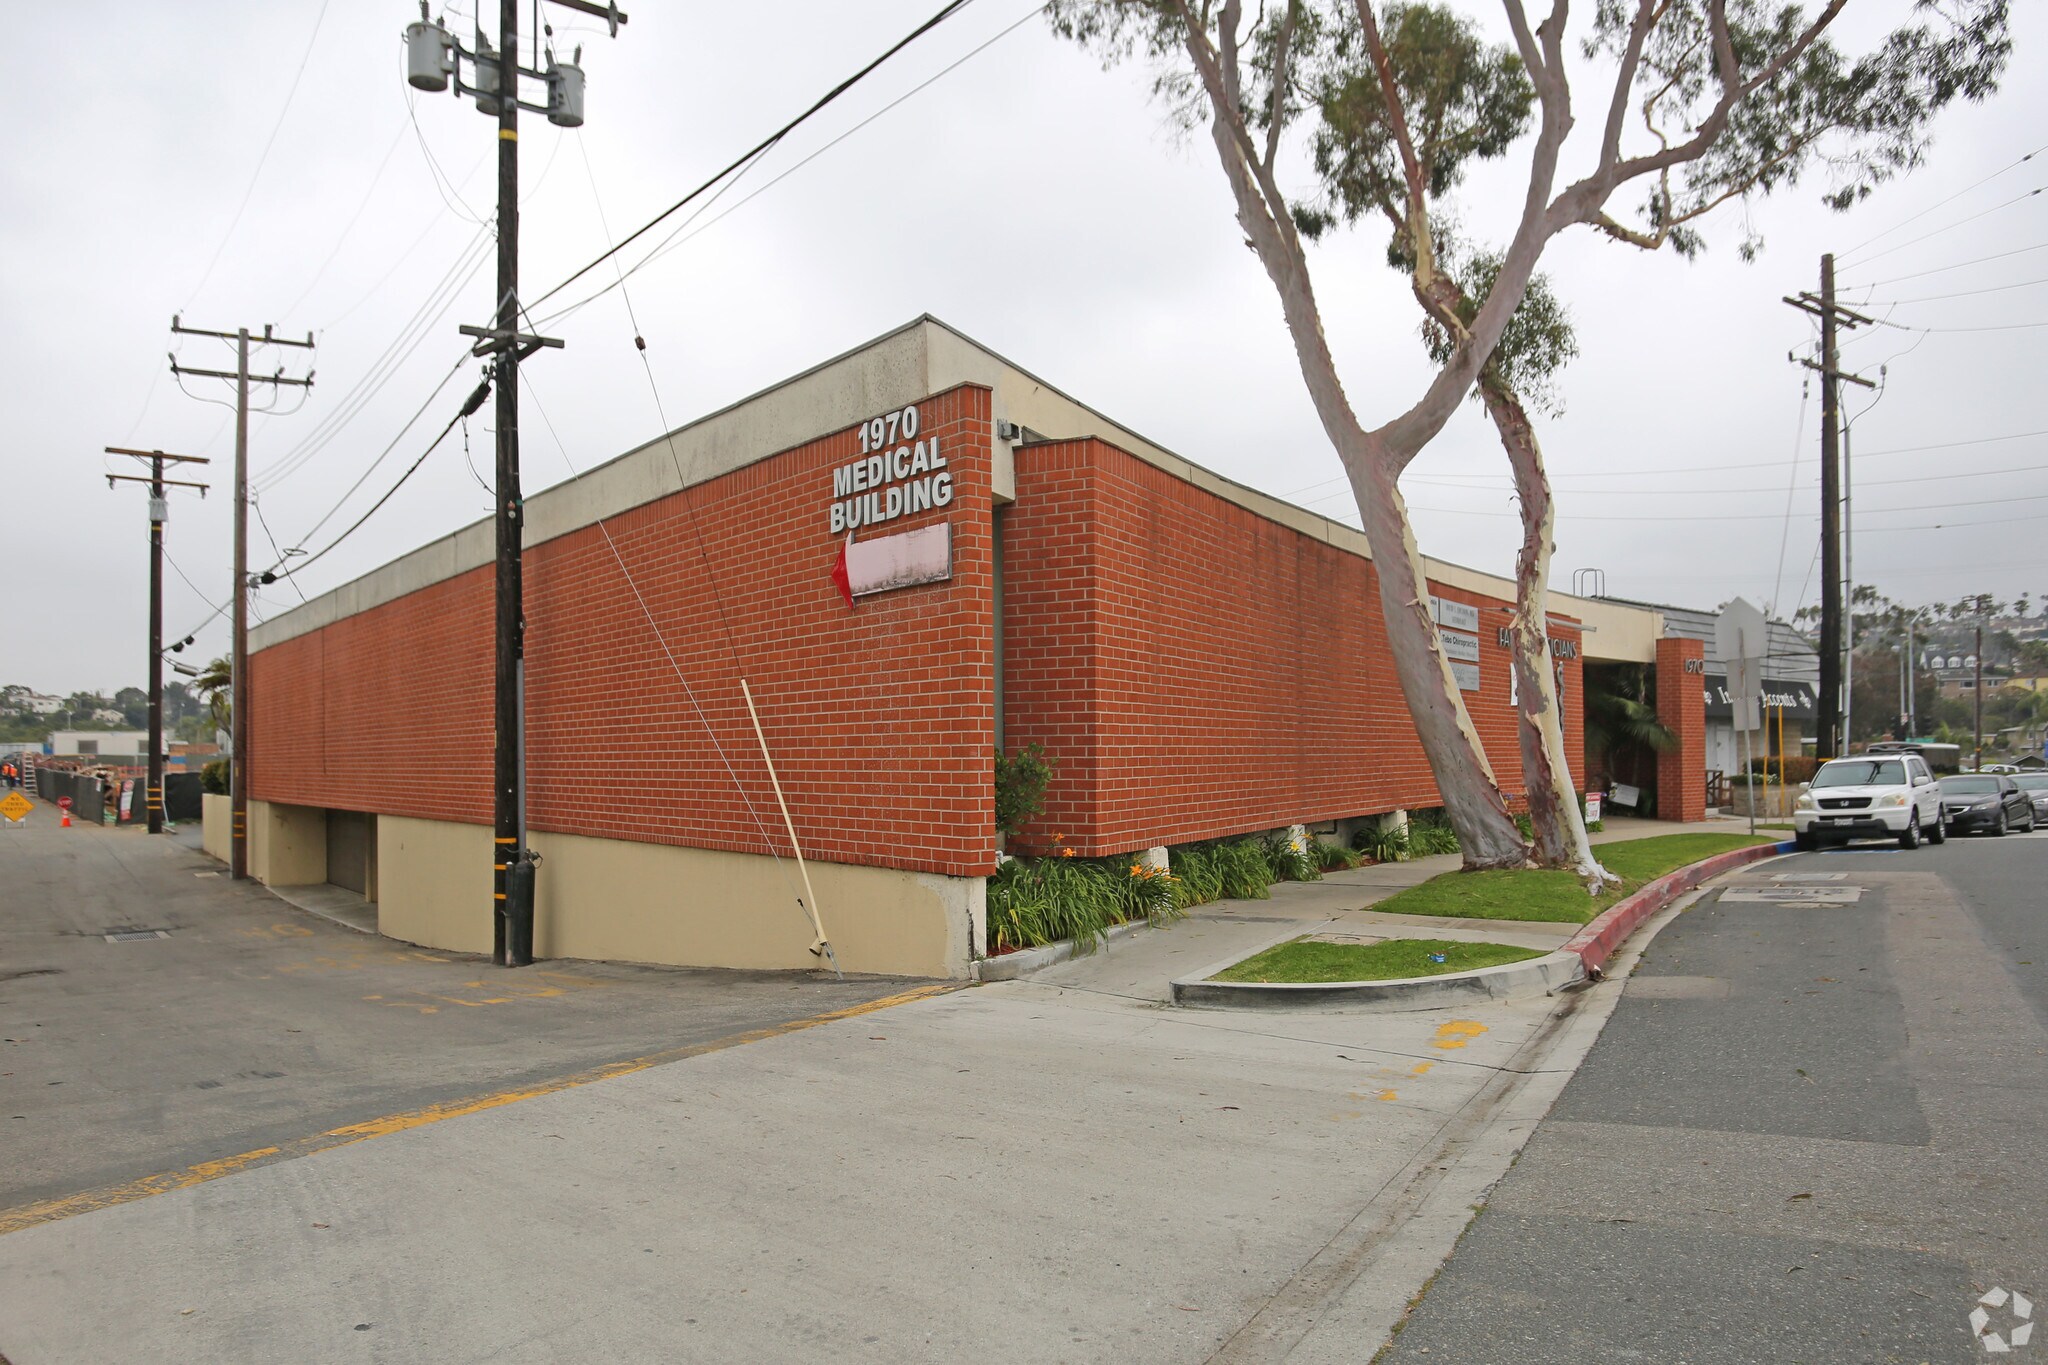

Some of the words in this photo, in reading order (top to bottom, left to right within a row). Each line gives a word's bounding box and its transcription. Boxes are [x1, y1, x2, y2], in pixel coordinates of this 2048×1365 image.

[858, 405, 919, 454] 1970
[833, 436, 947, 498] MEDICAL
[830, 472, 952, 534] BUILDING
[1685, 658, 1704, 674] 1970
